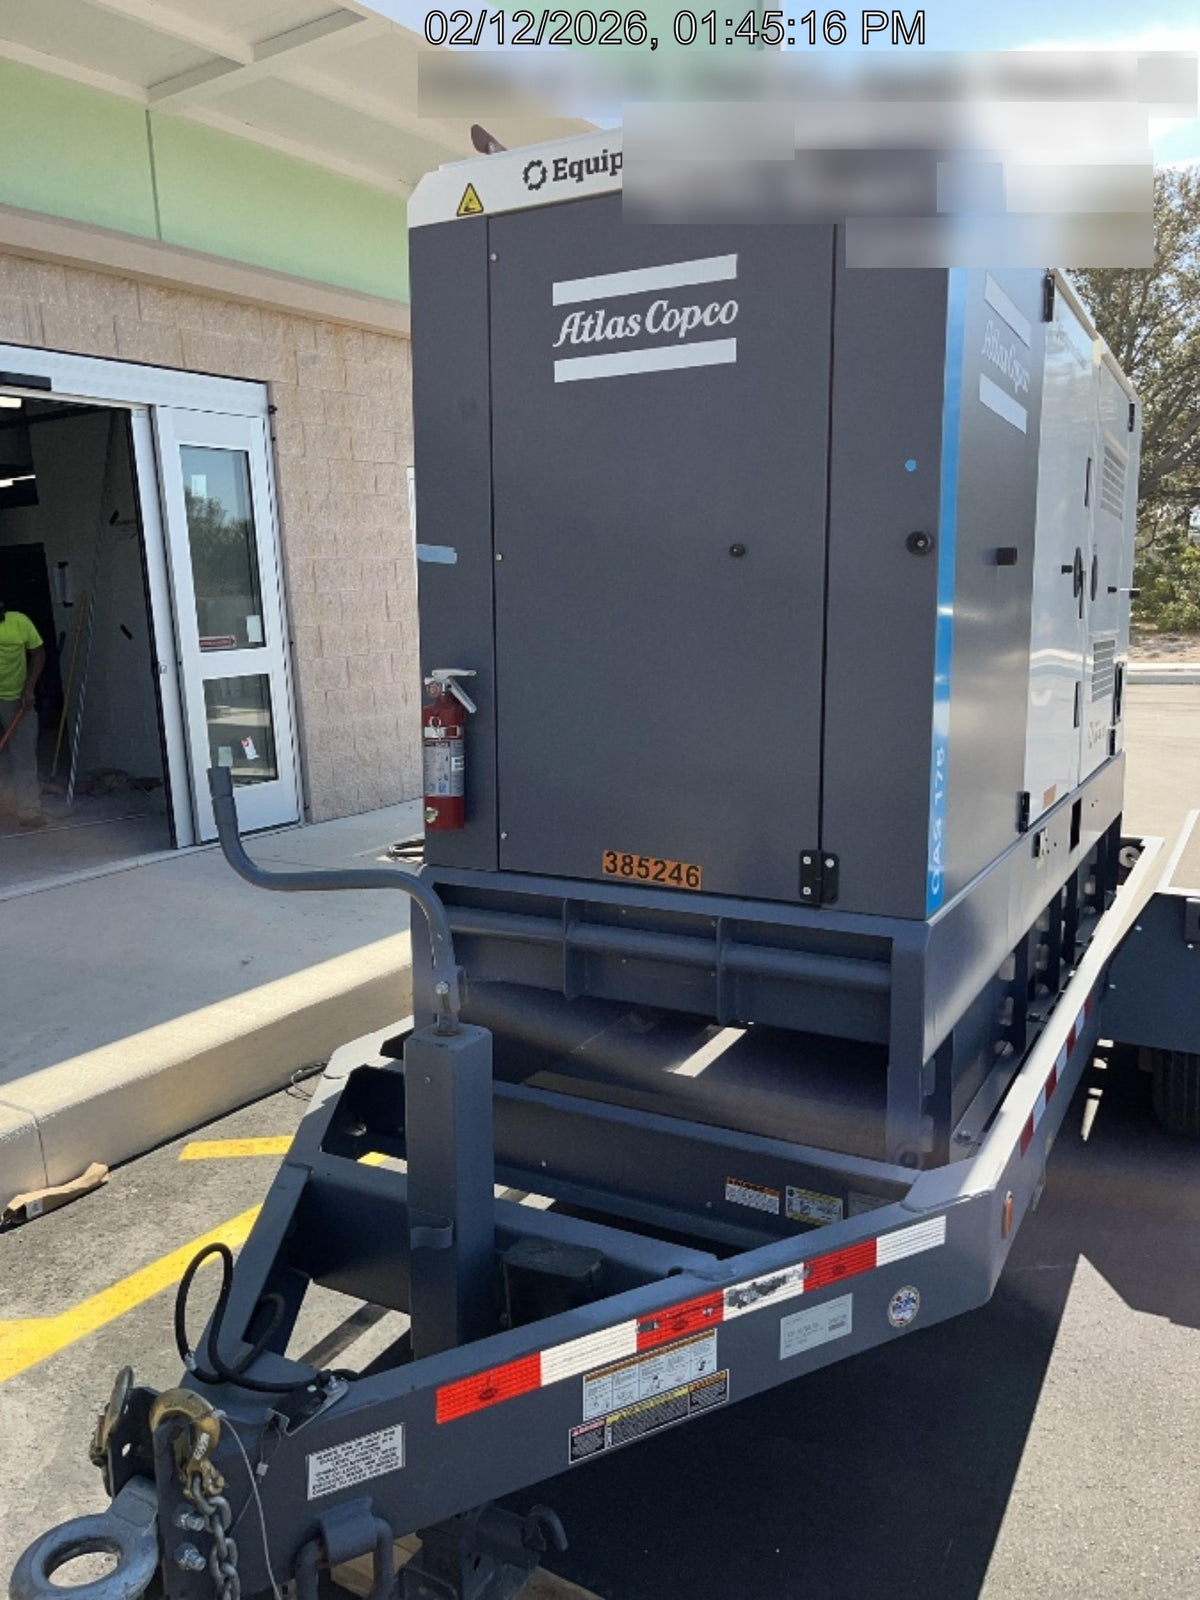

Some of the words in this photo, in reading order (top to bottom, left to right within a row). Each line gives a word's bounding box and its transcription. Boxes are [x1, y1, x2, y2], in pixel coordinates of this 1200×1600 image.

[552, 309, 641, 348] Atlas
[645, 299, 739, 339] Copco
[604, 850, 700, 888] 385246
